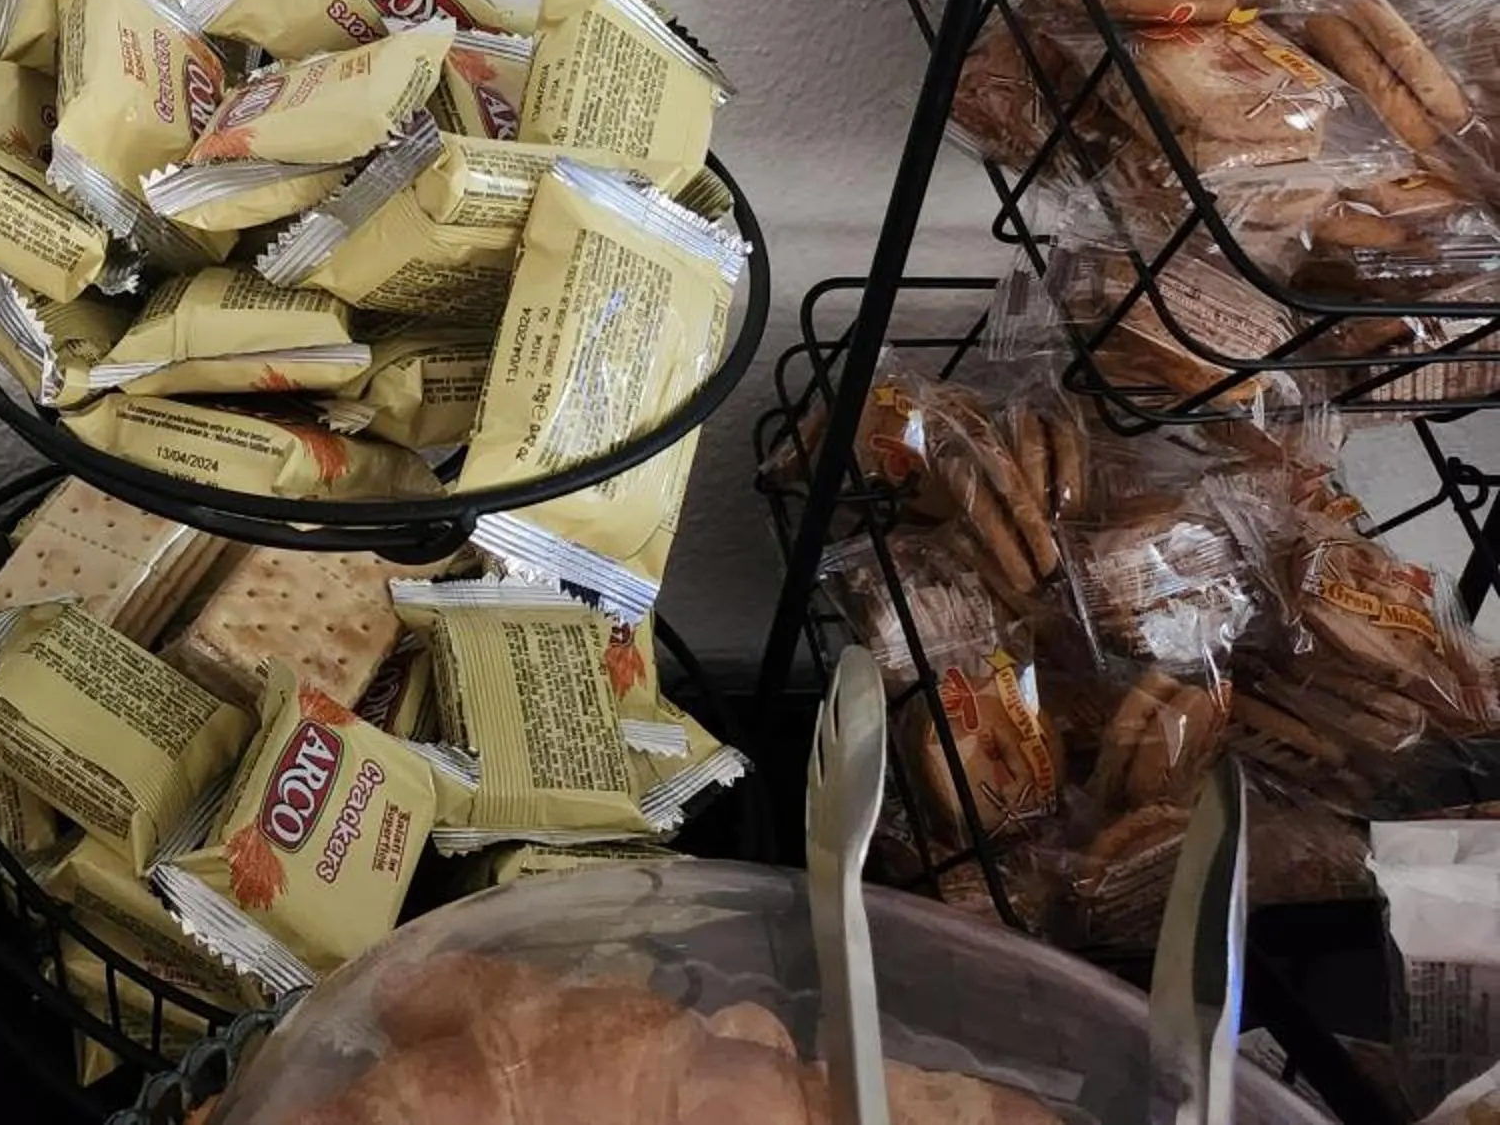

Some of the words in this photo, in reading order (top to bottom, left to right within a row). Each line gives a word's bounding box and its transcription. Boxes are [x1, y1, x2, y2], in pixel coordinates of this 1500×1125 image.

[157, 447, 219, 471] 13/04/2024
[271, 727, 335, 842] ARCO
[315, 758, 386, 884] Crackers
